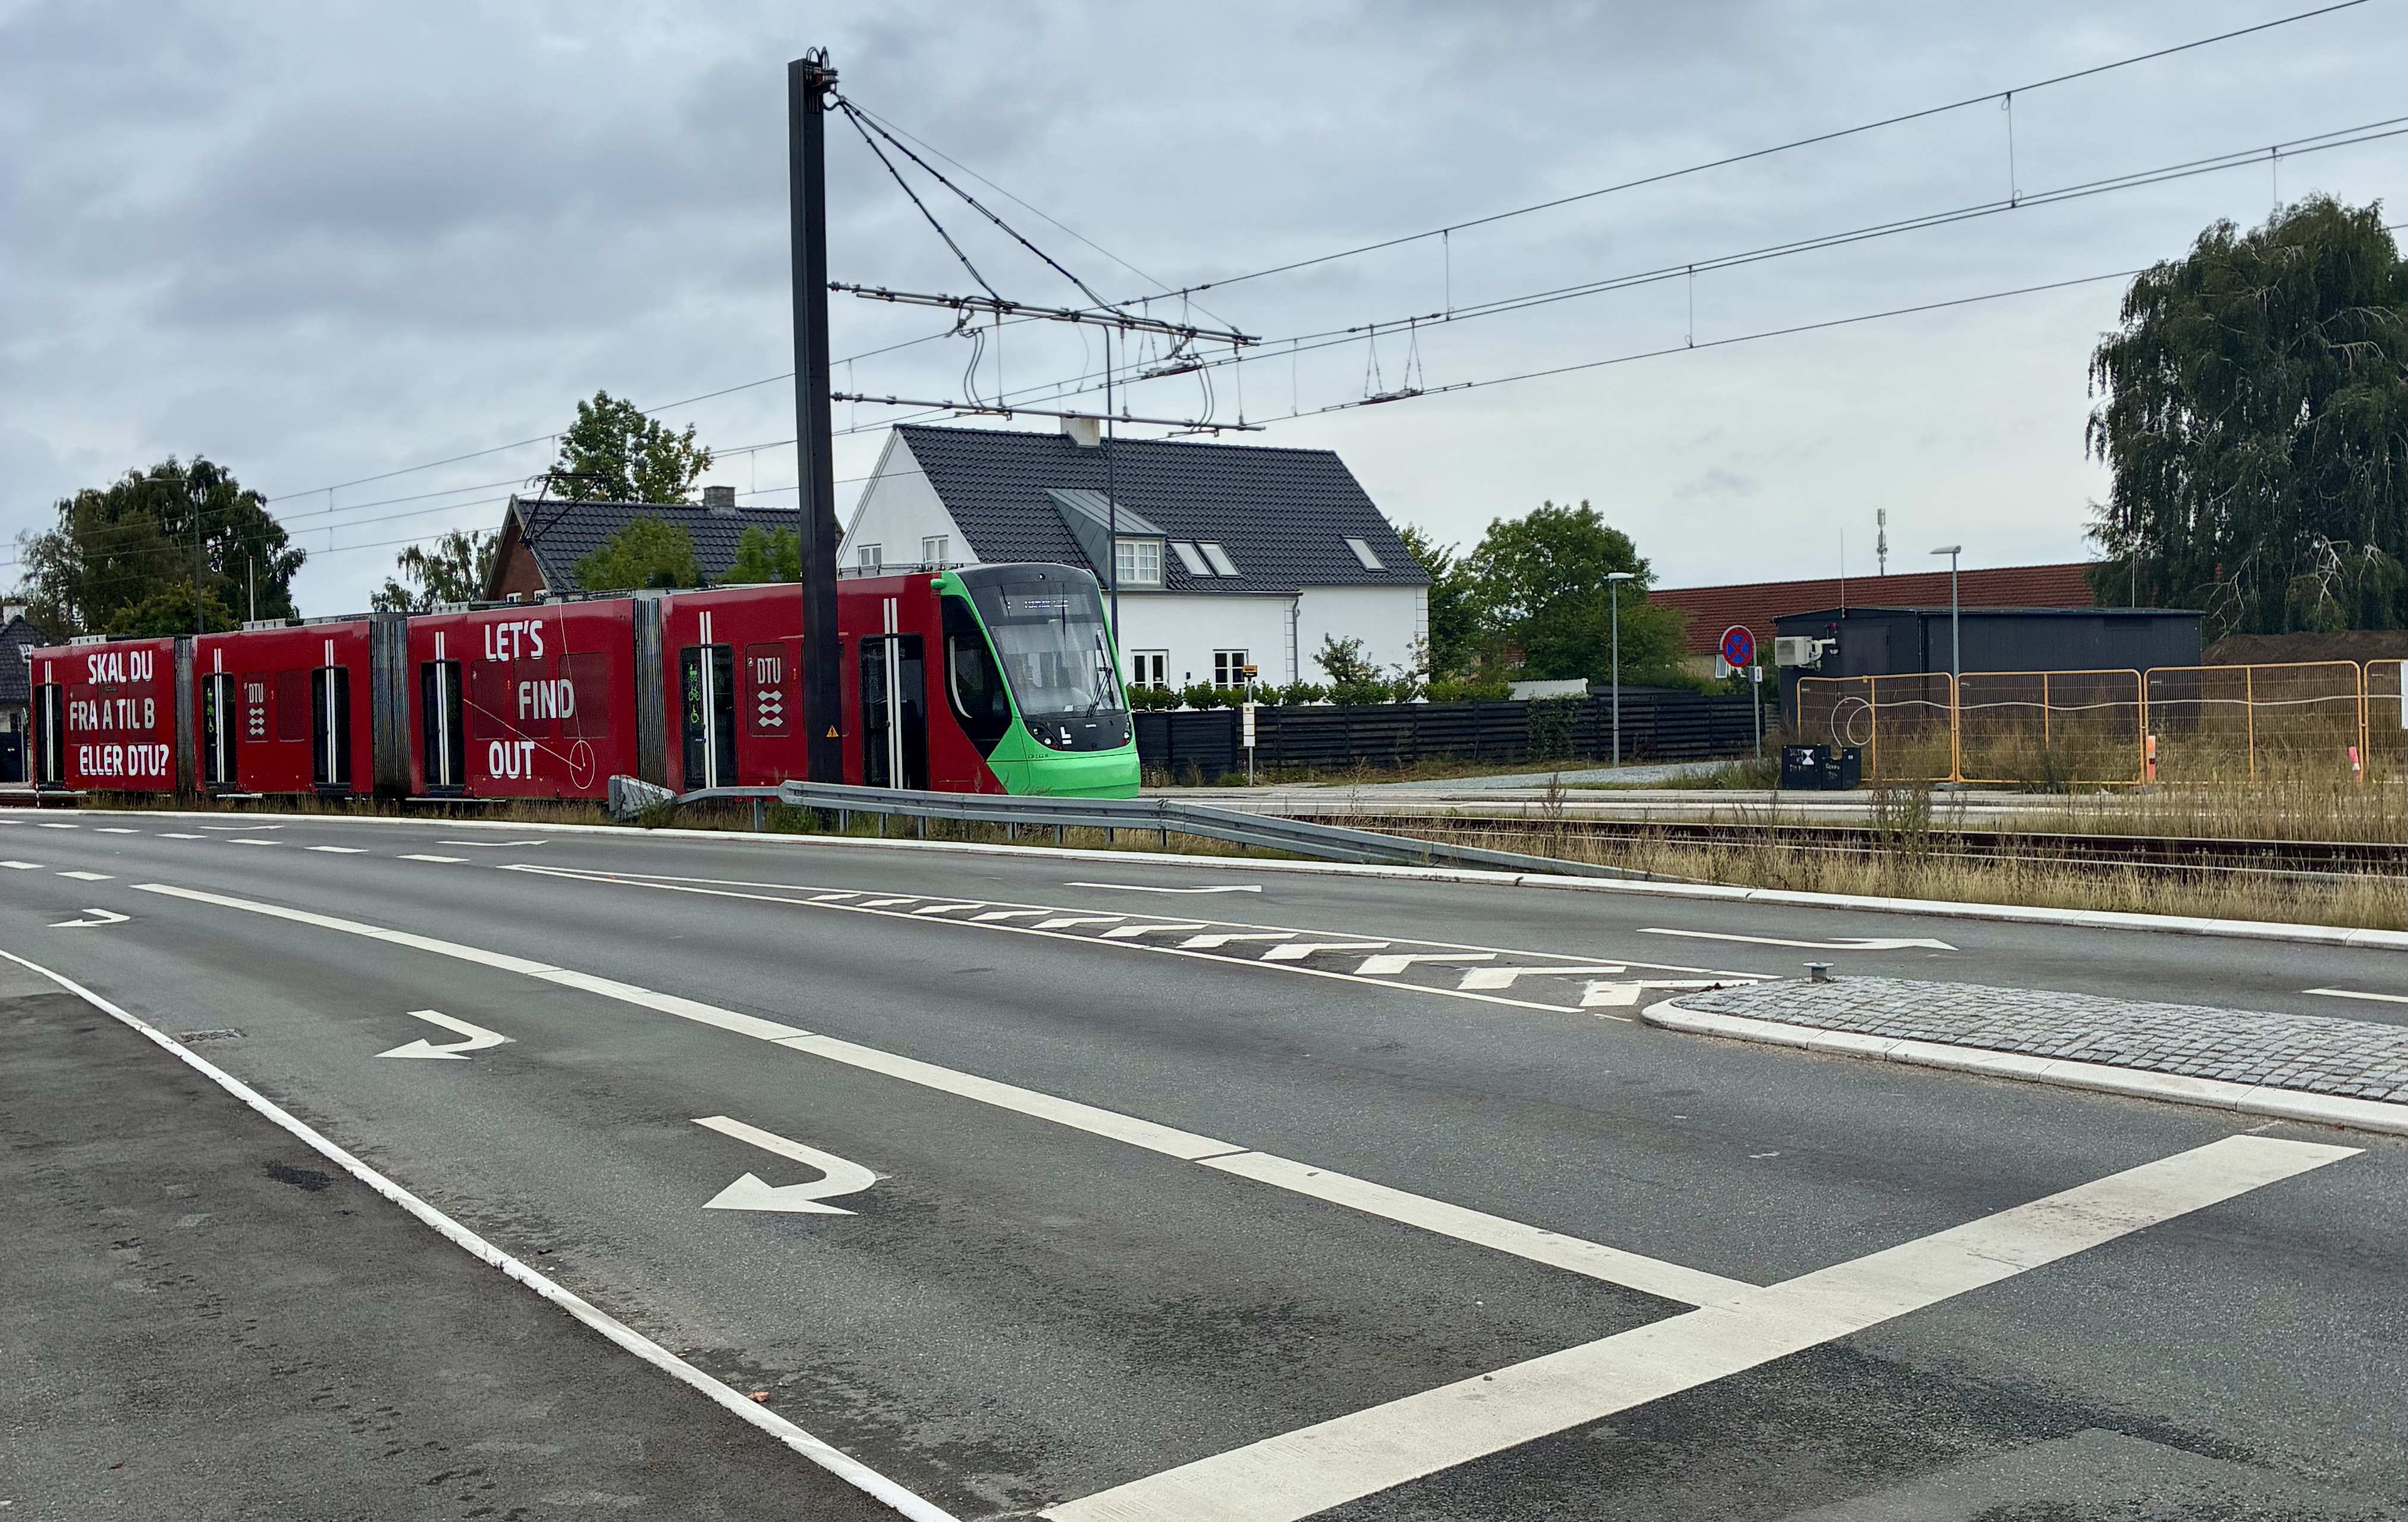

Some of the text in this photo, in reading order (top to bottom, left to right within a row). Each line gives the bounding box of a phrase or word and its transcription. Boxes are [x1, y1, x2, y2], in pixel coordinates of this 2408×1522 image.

[485, 620, 543, 661] LET'S
[88, 650, 152, 684] SKAL DU
[757, 657, 780, 684] DTU
[249, 683, 263, 703] DTU
[519, 679, 574, 720] FIND
[70, 698, 155, 731] FRA A TIL B
[80, 744, 169, 776] ELLER DTU?
[489, 741, 535, 779] OUT
